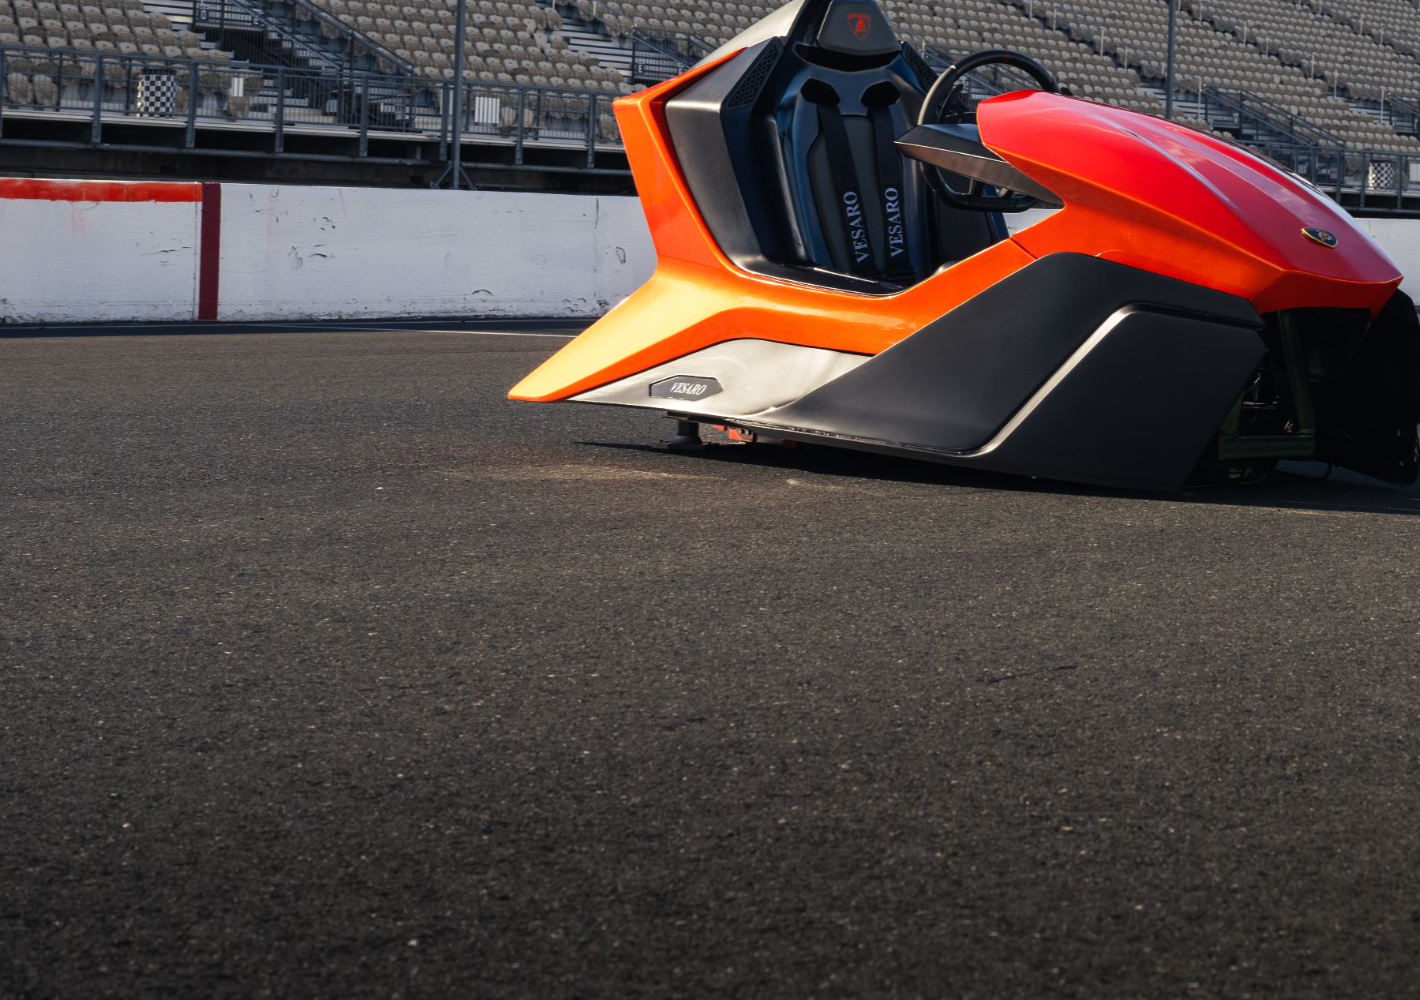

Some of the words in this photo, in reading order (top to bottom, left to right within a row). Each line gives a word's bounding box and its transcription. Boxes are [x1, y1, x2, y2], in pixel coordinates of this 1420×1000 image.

[843, 191, 870, 263] VESARO
[884, 187, 905, 258] VESARO
[670, 382, 708, 396] VESARO
